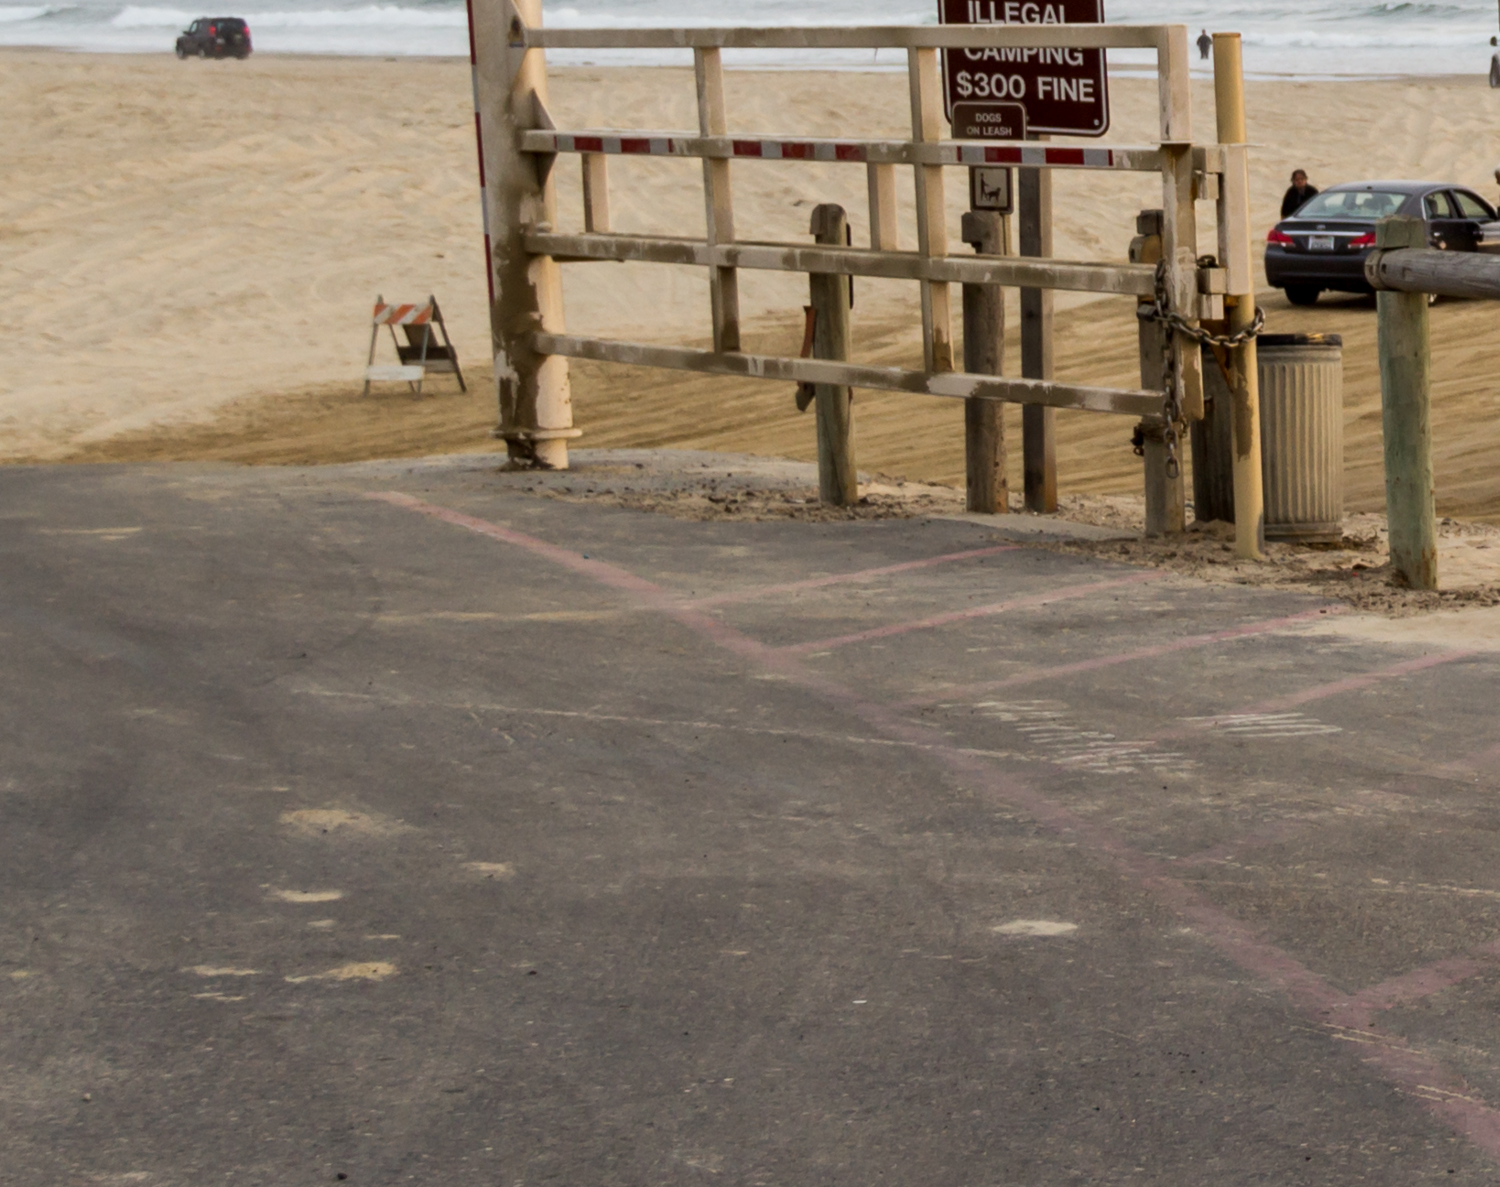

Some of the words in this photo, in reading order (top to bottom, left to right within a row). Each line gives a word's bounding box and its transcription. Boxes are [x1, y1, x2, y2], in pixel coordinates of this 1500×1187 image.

[964, 47, 1084, 66] CAMPING
[956, 71, 1025, 98] $300
[1037, 76, 1095, 102] FINE
[975, 113, 1001, 122] DOGS
[967, 127, 979, 135] ON
[983, 127, 1012, 136] LEASH
